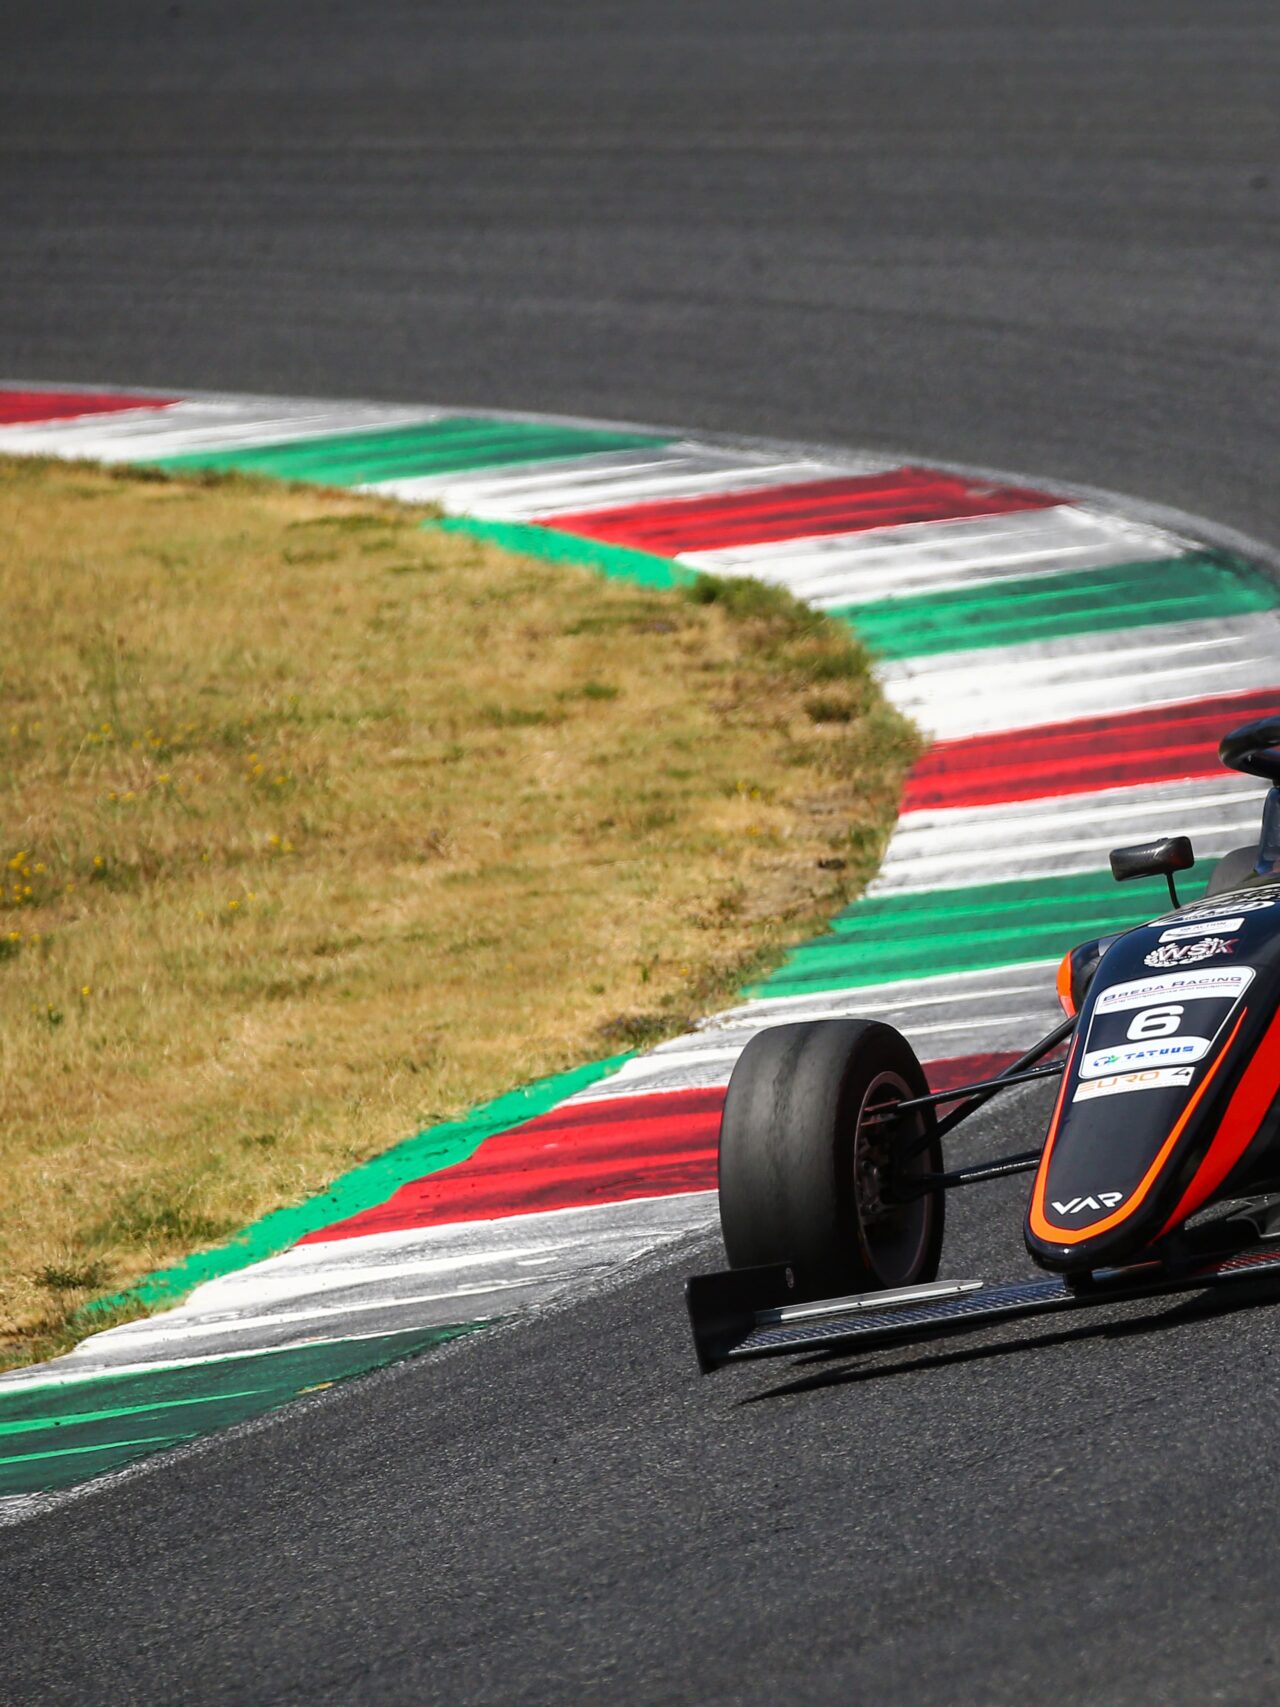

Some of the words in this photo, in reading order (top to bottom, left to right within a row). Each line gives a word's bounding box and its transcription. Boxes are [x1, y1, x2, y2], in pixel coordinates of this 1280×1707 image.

[1159, 938, 1240, 960] WSK
[1103, 984, 1165, 1002] BREDA
[1171, 976, 1242, 987] RACING
[1126, 1005, 1185, 1041] 6
[1124, 1045, 1195, 1060] TATUUS
[1079, 1071, 1161, 1094] EURO
[1171, 1068, 1191, 1077] 4
[1051, 1191, 1124, 1215] VAR
